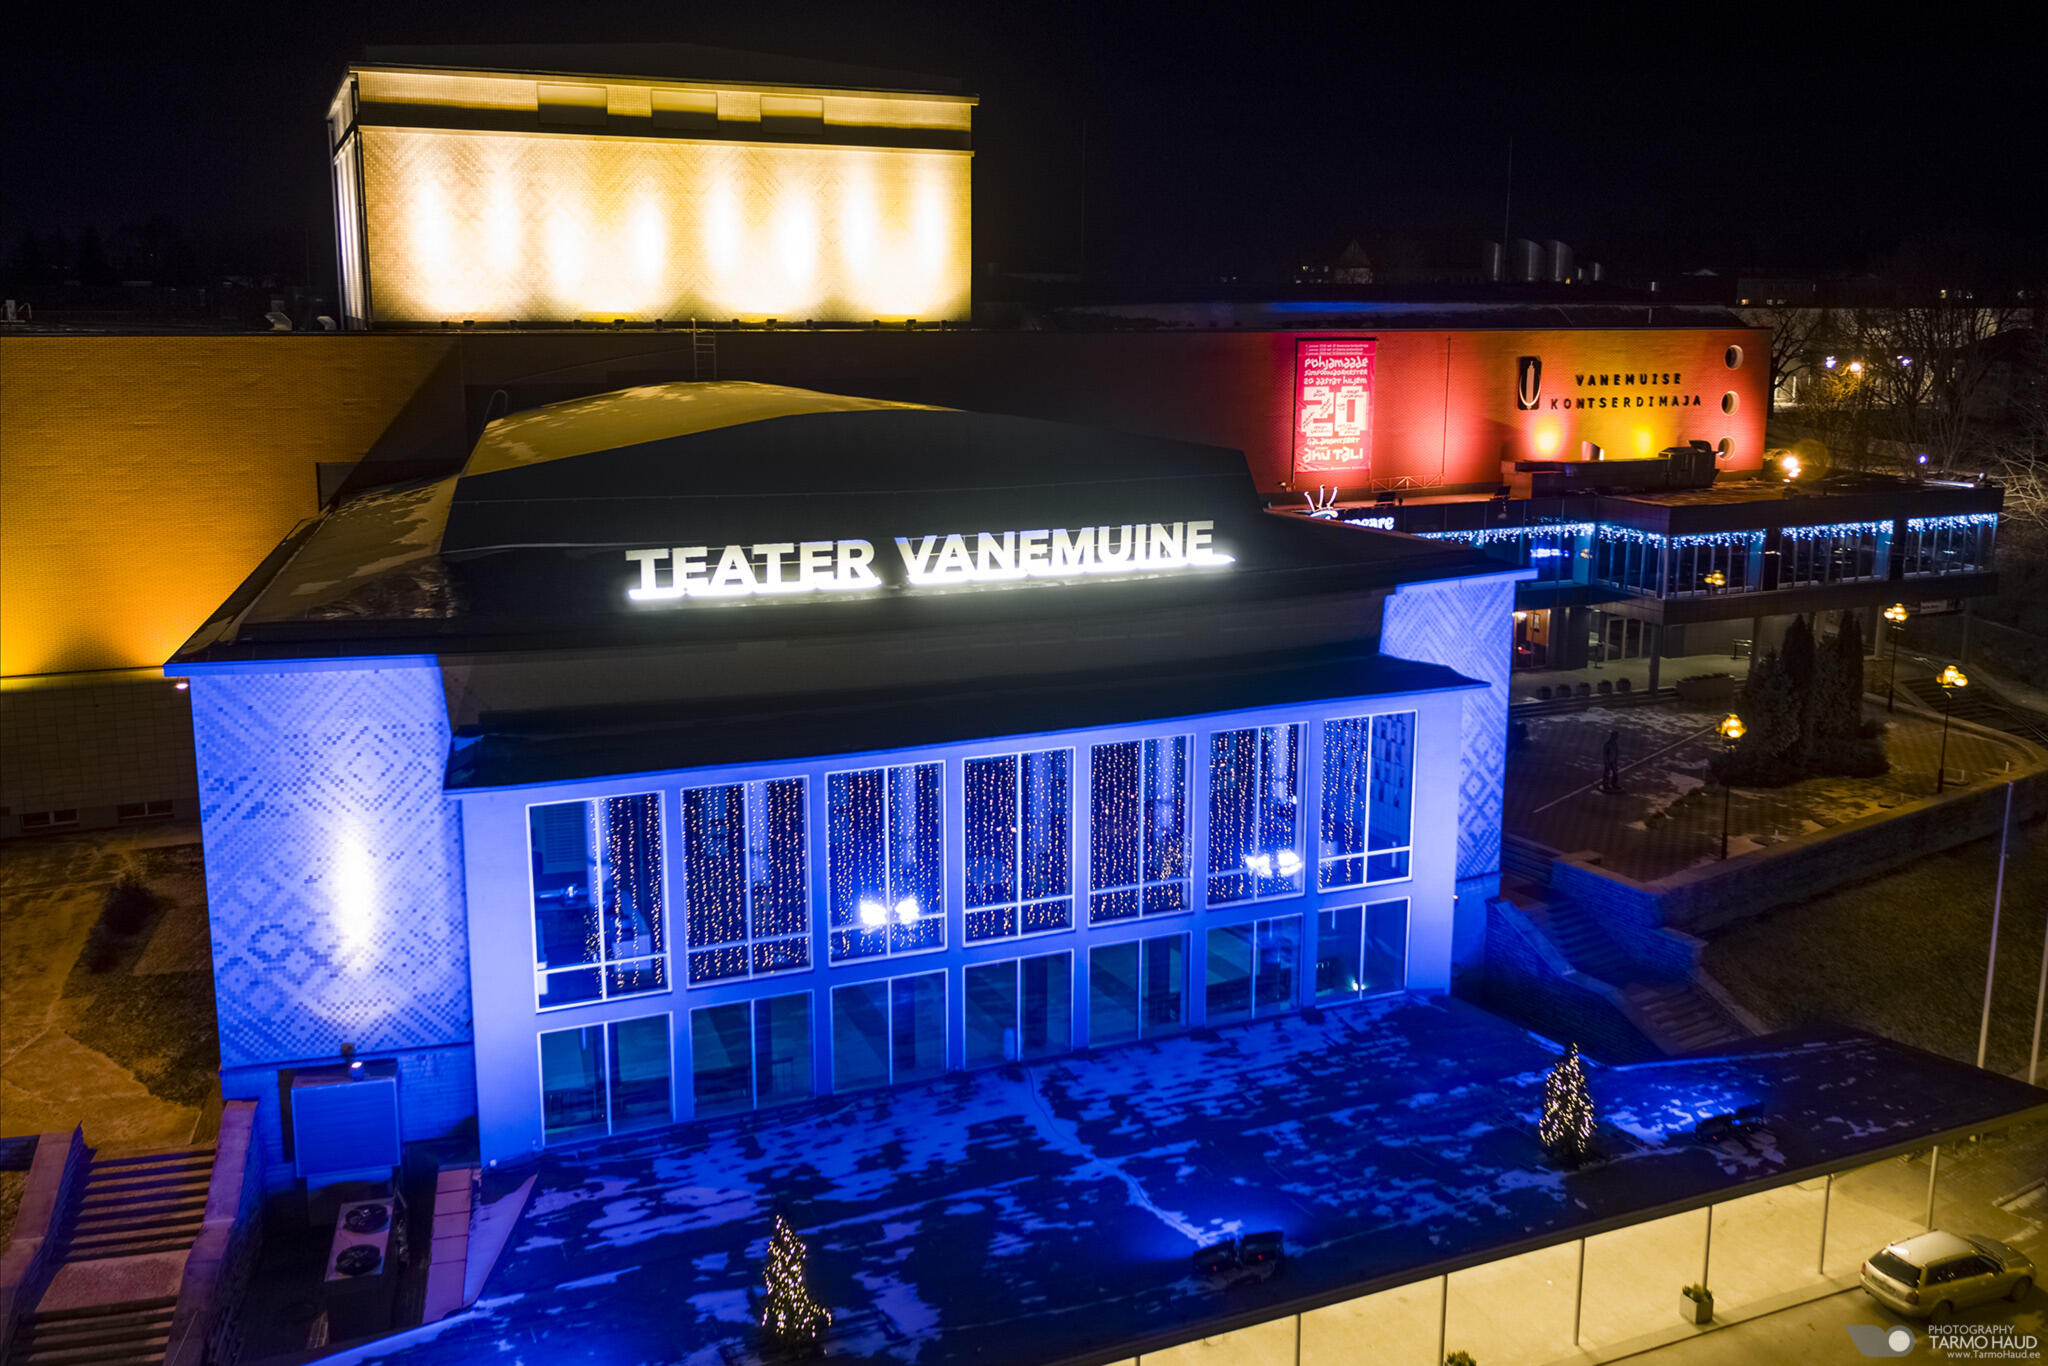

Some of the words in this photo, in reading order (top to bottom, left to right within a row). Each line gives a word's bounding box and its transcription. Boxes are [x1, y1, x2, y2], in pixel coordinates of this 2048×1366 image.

[1576, 373, 1682, 386] VANEMUISE
[1301, 386, 1368, 437] 20
[1551, 395, 1702, 410] KONTSERDIMAJA
[625, 537, 882, 600] TEATER
[894, 520, 1236, 585] VANEMUINE
